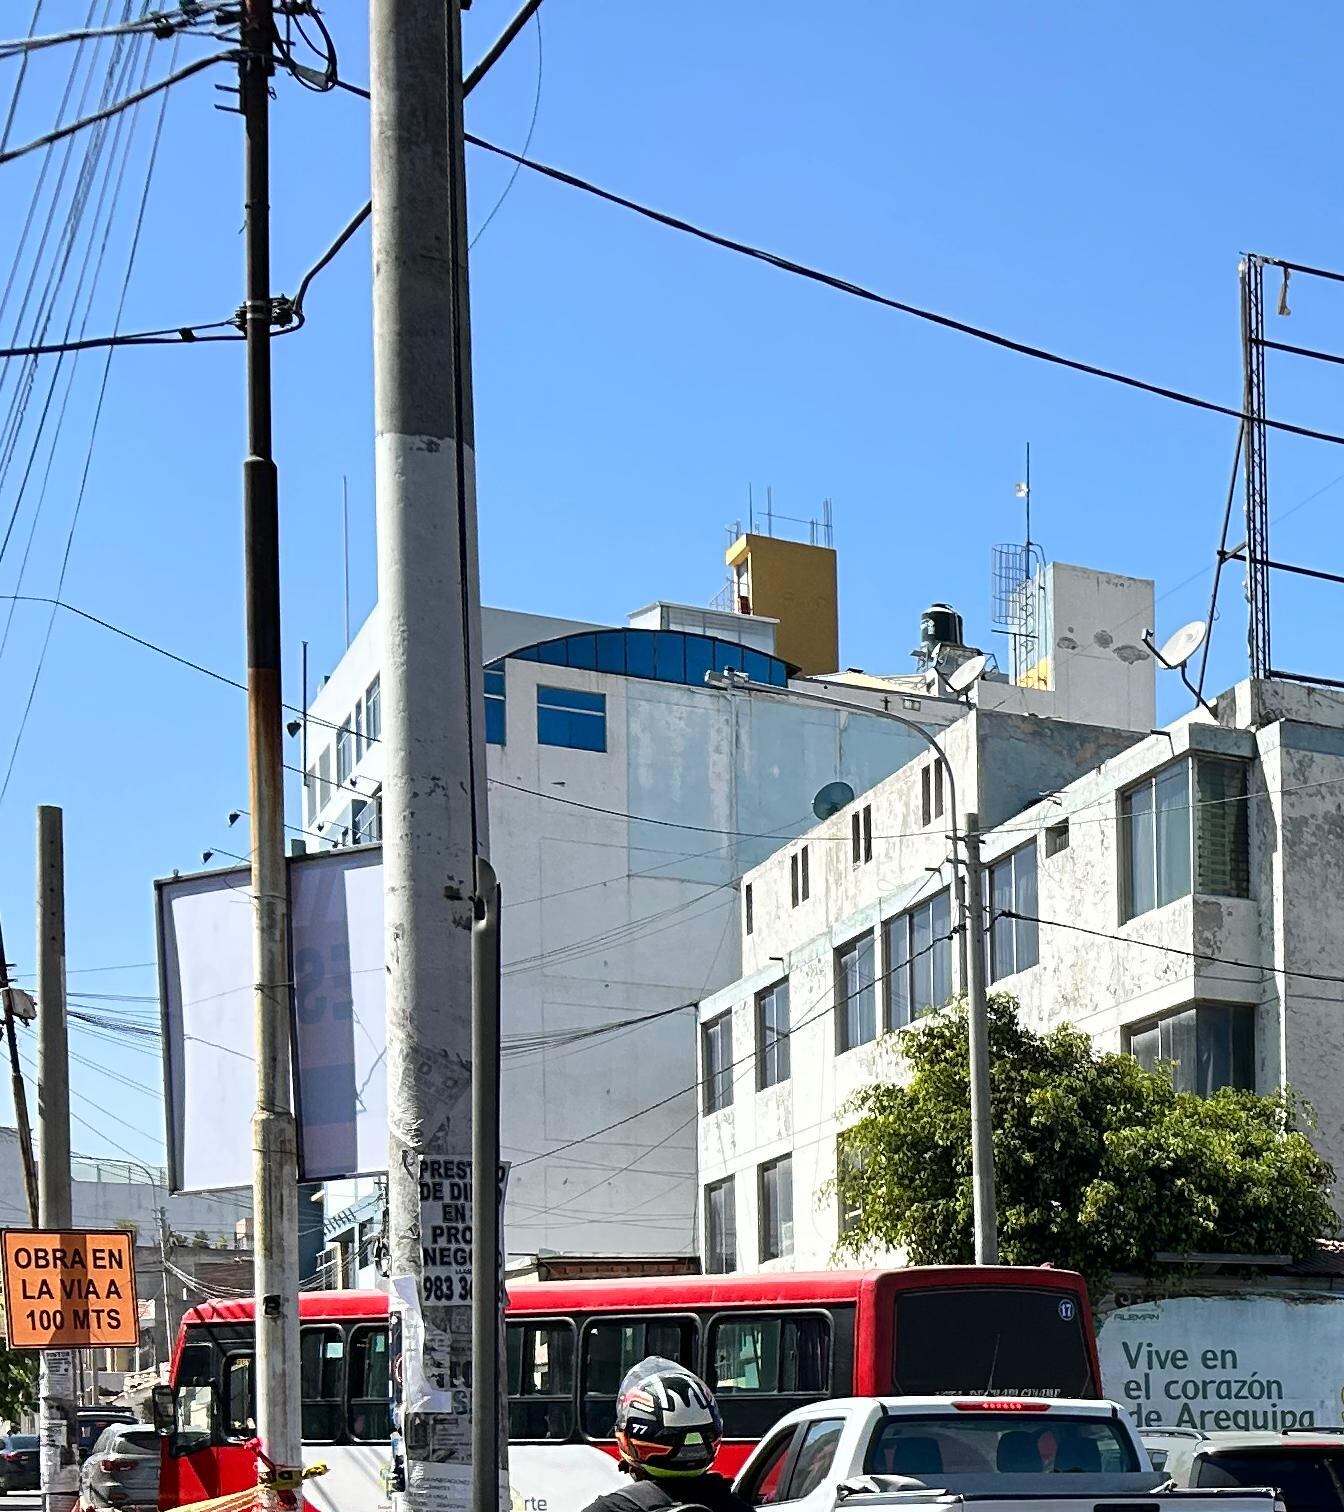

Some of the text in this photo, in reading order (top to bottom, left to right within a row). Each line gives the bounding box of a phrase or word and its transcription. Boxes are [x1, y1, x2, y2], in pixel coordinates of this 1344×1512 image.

[420, 1182, 443, 1201] DE
[442, 1203, 466, 1223] EN
[14, 1248, 123, 1269] OBRA EN
[21, 1279, 122, 1299] LA VIA A
[423, 1276, 453, 1301] 983
[26, 1309, 121, 1330] 100 MTS
[1122, 1341, 1238, 1370] Vive en
[1124, 1371, 1283, 1400] el corazón
[1129, 1403, 1162, 1428] de
[632, 1424, 648, 1434] 77
